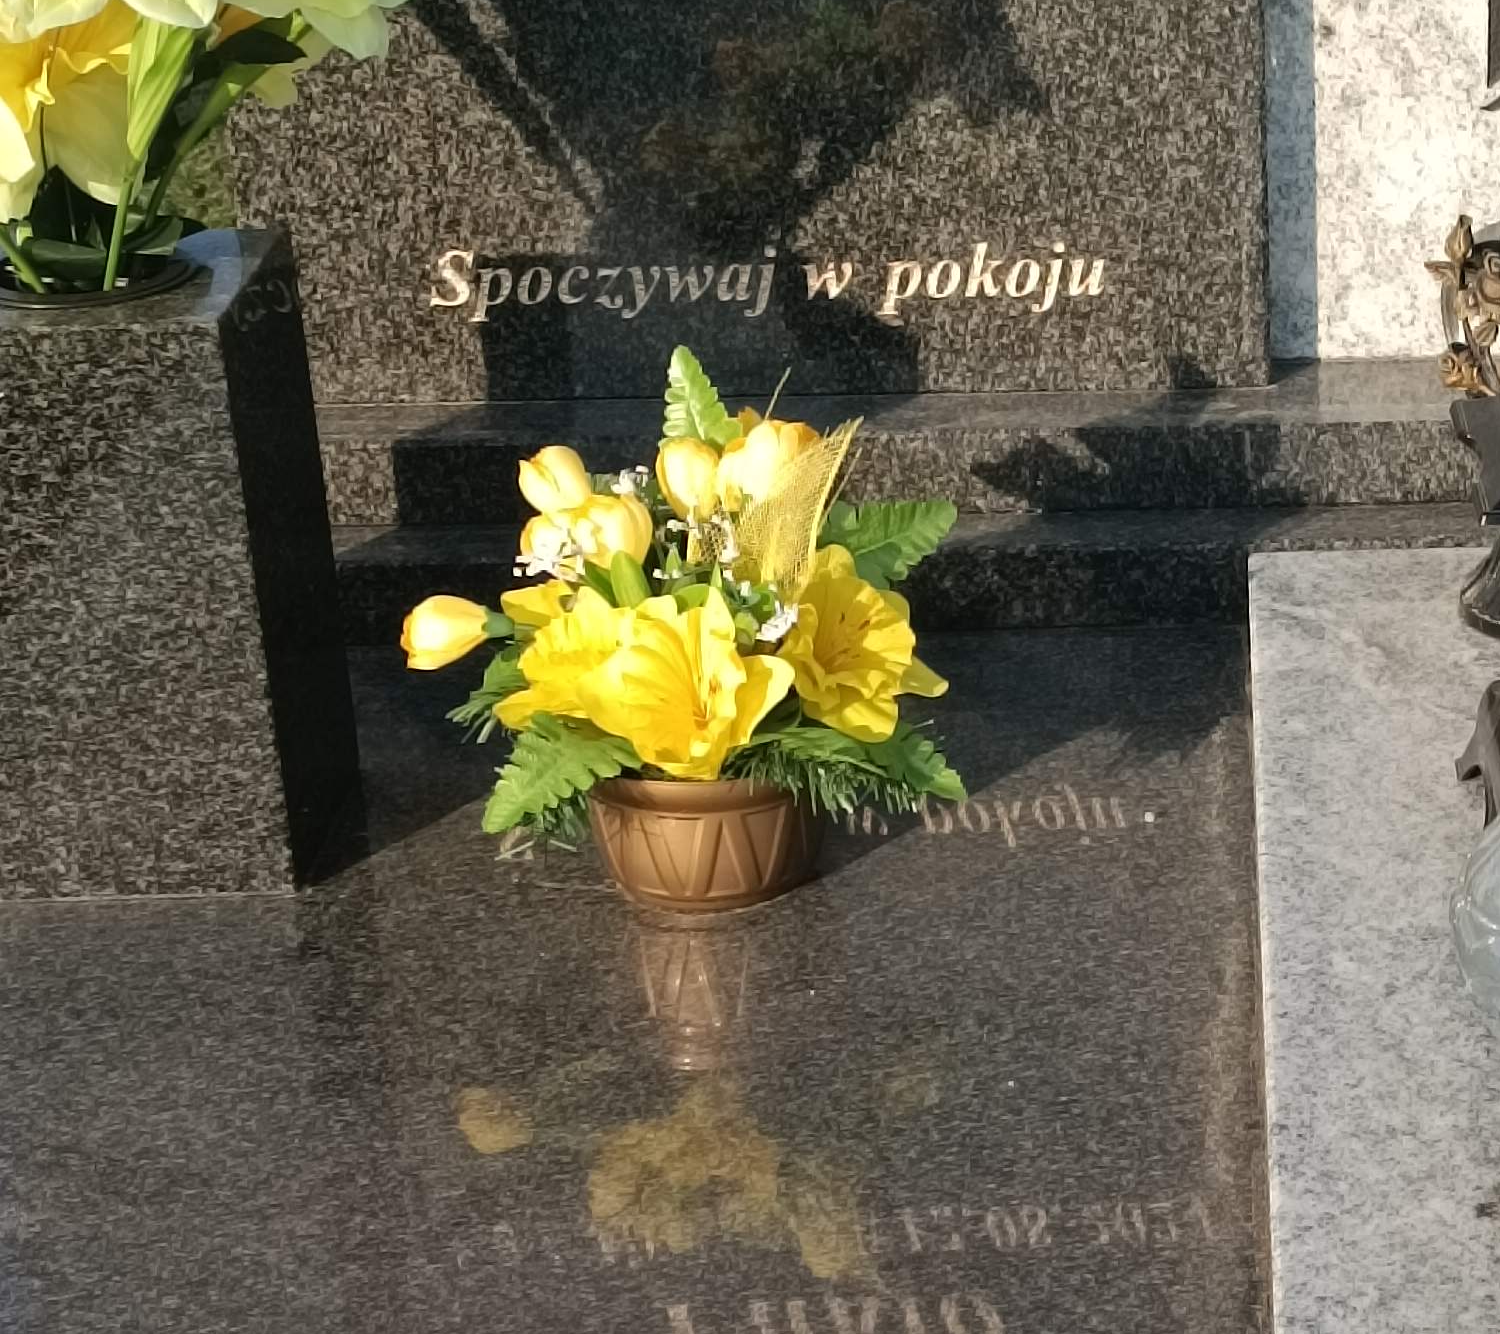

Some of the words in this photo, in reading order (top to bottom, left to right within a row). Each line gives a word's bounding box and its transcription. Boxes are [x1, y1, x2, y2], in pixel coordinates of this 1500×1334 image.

[429, 244, 776, 323] Spoczywaj
[804, 256, 853, 301] w
[879, 241, 1107, 315] pokoju
